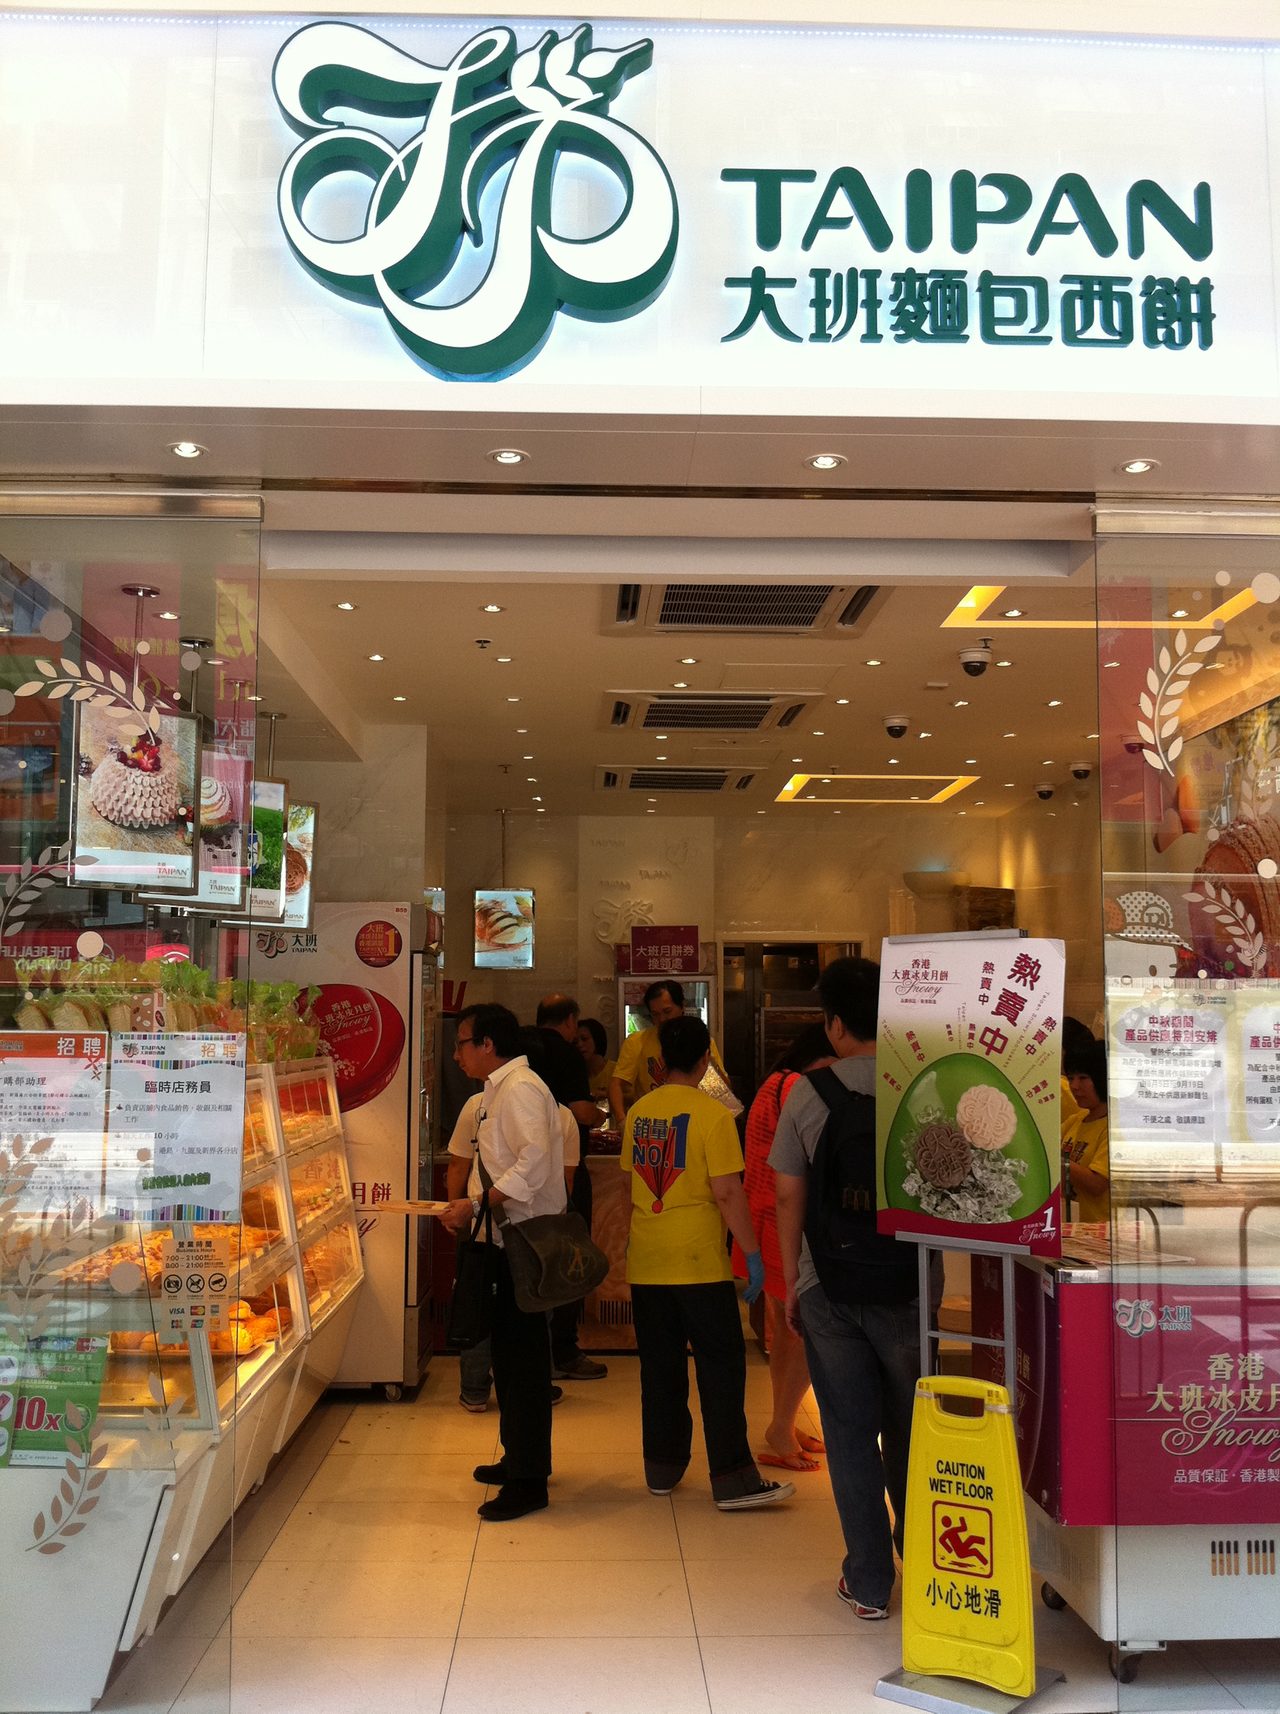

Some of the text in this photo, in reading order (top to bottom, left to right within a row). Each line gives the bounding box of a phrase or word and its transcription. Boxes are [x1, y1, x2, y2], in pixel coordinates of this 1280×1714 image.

[720, 166, 1213, 262] TAIPAN
[721, 266, 1216, 351] 大班麵包西餅
[157, 867, 187, 876] TAIPAN
[209, 884, 235, 893] TAIPAN
[291, 934, 317, 947] 大班
[636, 945, 694, 957] 大班月餅券
[648, 958, 683, 970] 換領處
[911, 958, 931, 969] 香港
[891, 969, 949, 981] 大班冰皮月餅
[895, 979, 943, 998] Snowy
[978, 961, 995, 1006] 熱賣中
[978, 952, 1042, 1056] 熱賣中
[1149, 1015, 1194, 1028] 中秋期間
[1025, 1015, 1057, 1056] 熱賣中
[1125, 1029, 1218, 1042] 產品供應特別安排
[57, 1037, 102, 1056] 招聘
[200, 1043, 238, 1058] 招聘
[0, 1076, 47, 1086] 購部助理
[144, 1080, 211, 1094] 臨時店務員
[633, 1116, 668, 1140] 銷量
[352, 1182, 392, 1204] 月餅
[178, 1240, 212, 1248] 營業時間
[169, 1307, 185, 1315] VISA
[1158, 1306, 1192, 1322] 大班
[1158, 1322, 1192, 1331] TAIPAN
[1207, 1352, 1265, 1381] 香港
[936, 1459, 985, 1480] CAUTION
[929, 1477, 994, 1501] WET FLOOR
[926, 1577, 1002, 1618] 小心地滑
